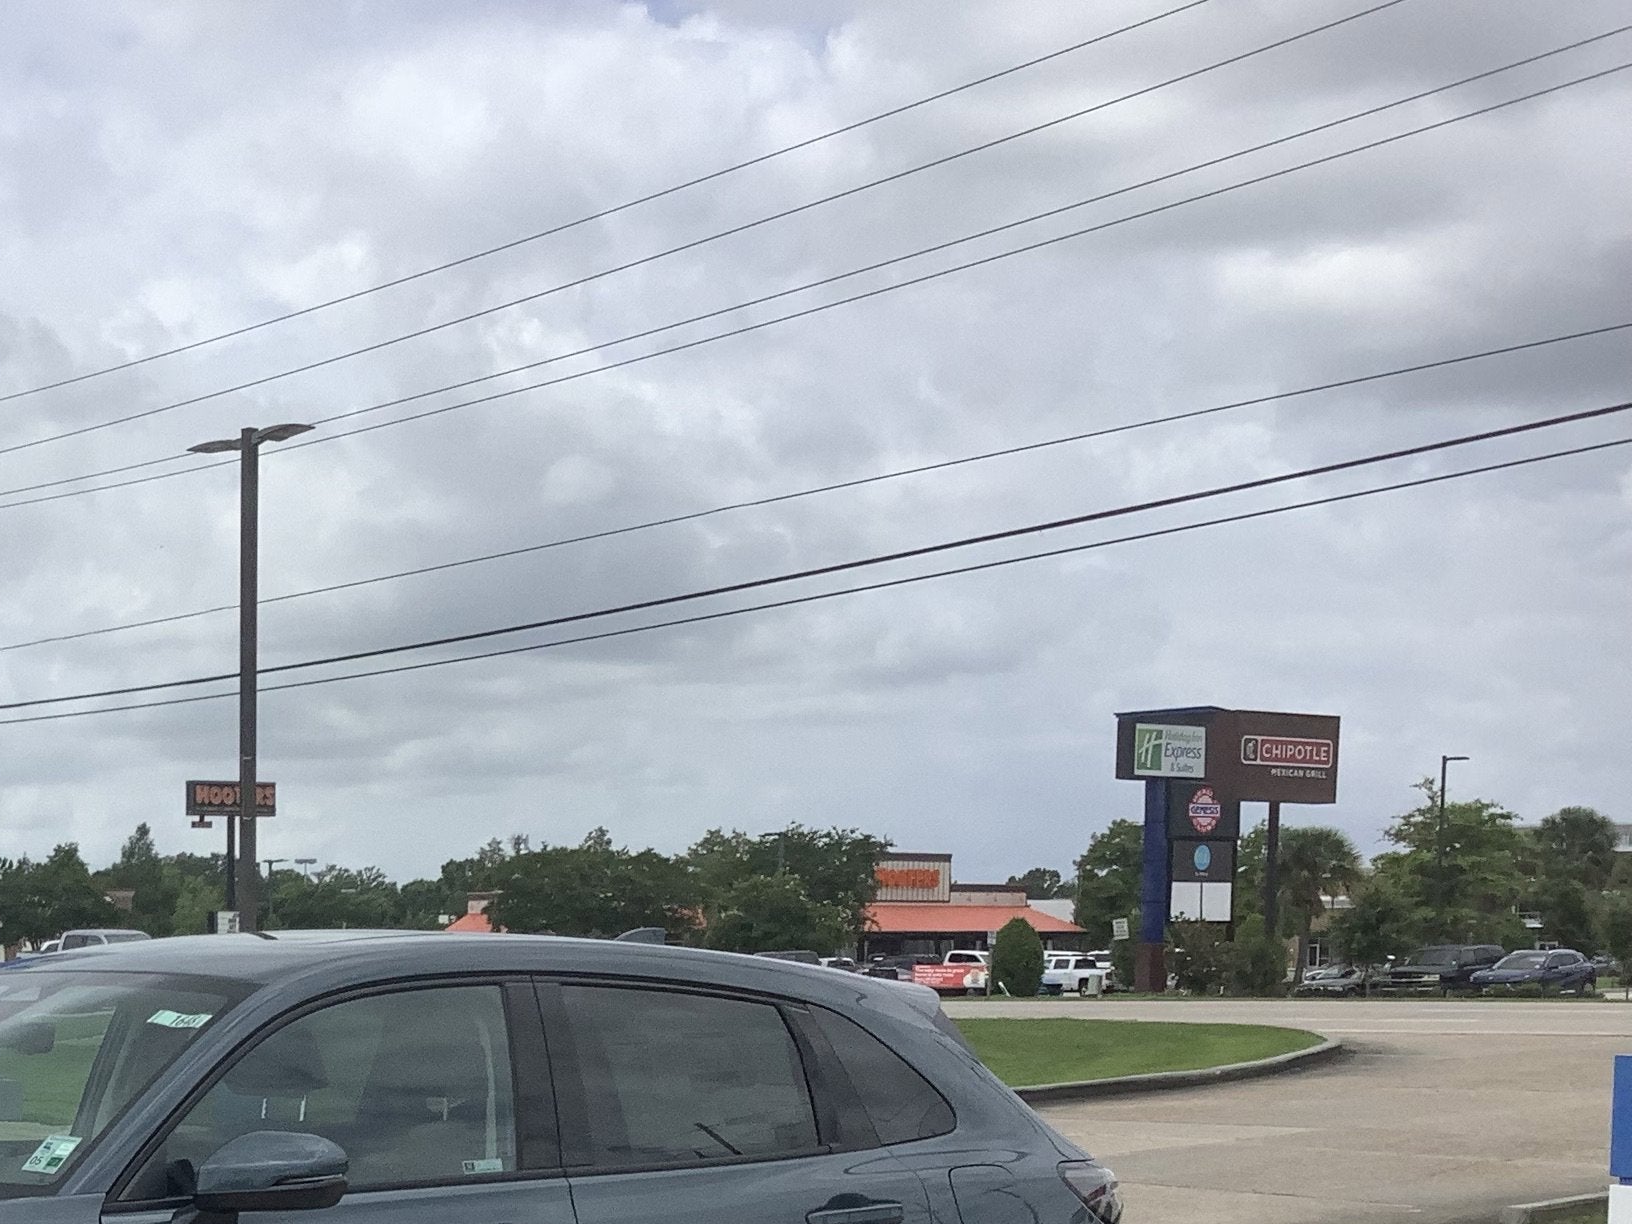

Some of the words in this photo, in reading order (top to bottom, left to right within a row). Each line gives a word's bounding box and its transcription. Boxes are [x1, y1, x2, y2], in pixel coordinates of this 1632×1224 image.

[1164, 742, 1203, 762] Express
[1262, 743, 1328, 761] CHIPOTLE
[1270, 768, 1304, 778] MEXICAN
[1305, 769, 1328, 779] GRILL
[195, 785, 274, 805] HOOTRS
